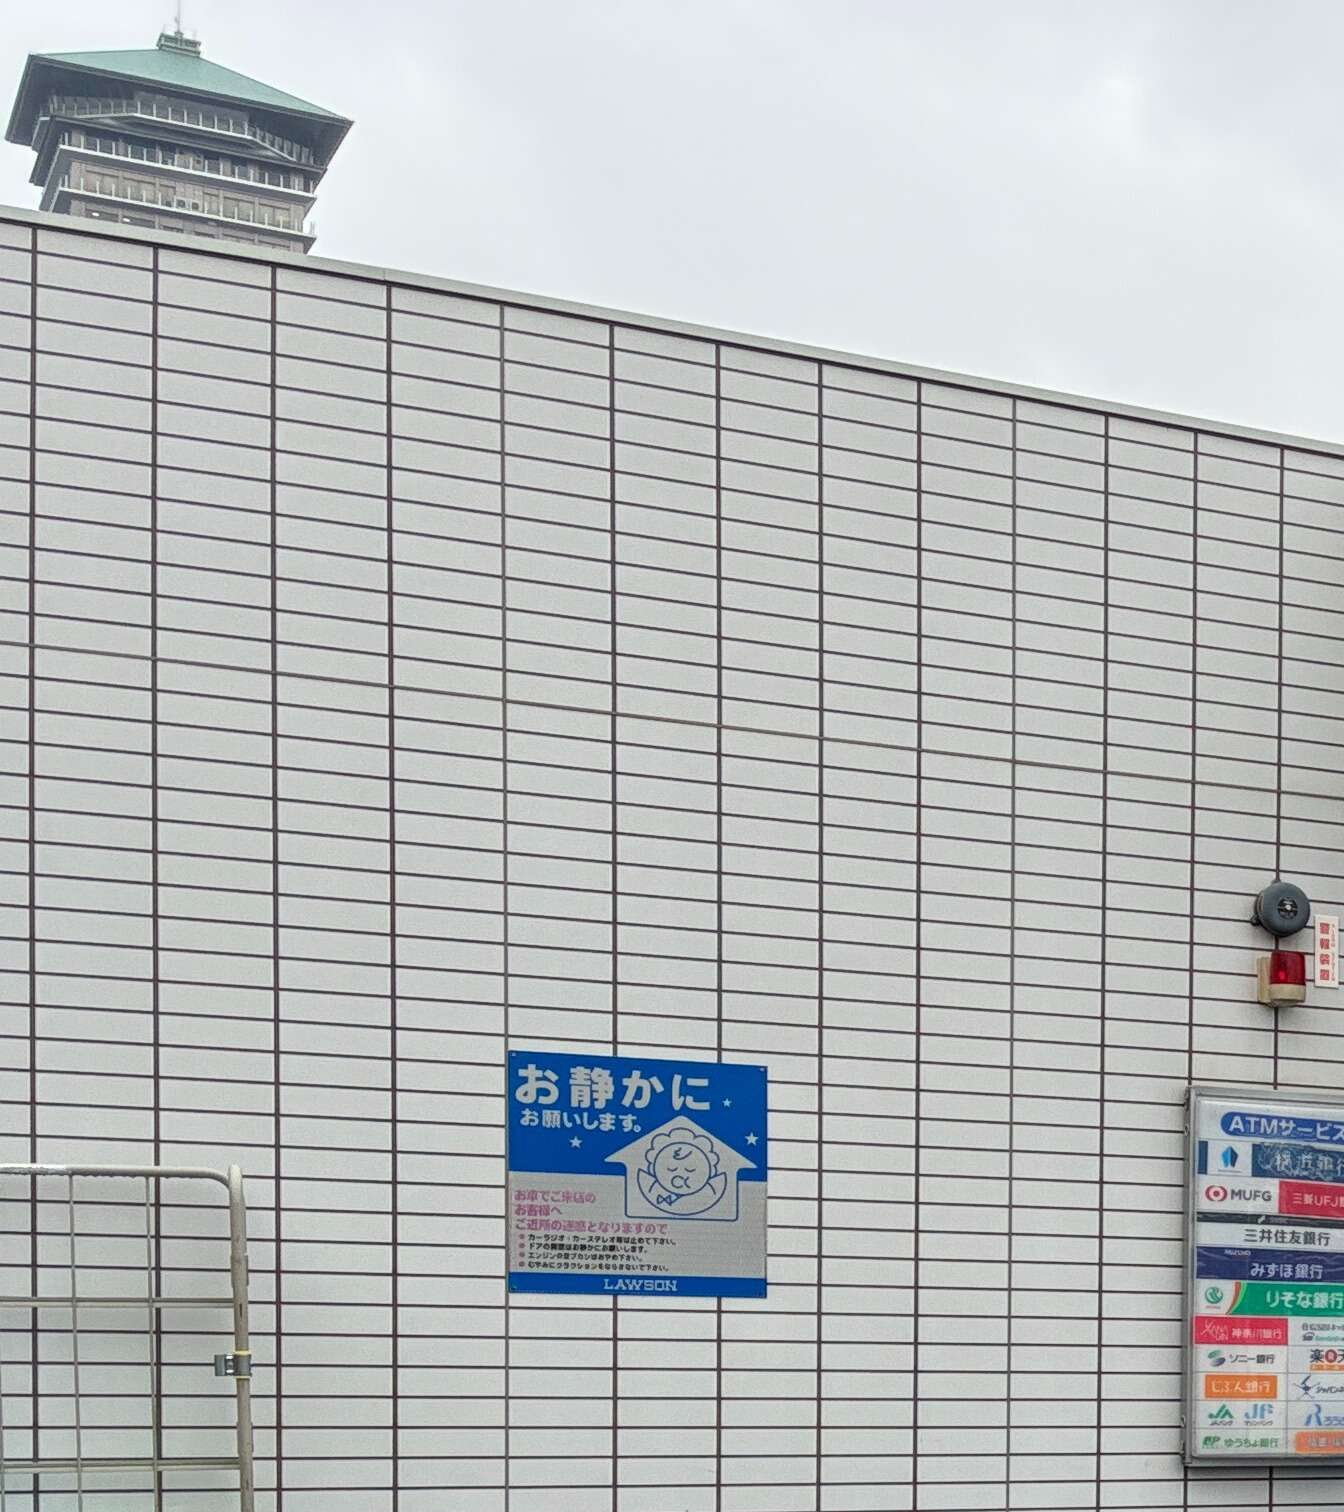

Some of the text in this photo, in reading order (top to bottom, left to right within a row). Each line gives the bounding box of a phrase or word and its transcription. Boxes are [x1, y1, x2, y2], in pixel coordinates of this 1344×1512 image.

[514, 1063, 711, 1111] お静かに
[519, 1108, 643, 1132] お願いします。
[1230, 1189, 1273, 1202] MUFG
[1243, 1228, 1332, 1246] 三井住友銀行
[1250, 1261, 1324, 1279] みずほ銀行
[603, 1278, 679, 1293] LAWSON
[1266, 1290, 1344, 1309] りそな銀行
[1229, 1353, 1275, 1365] ソニー銀行
[1211, 1379, 1271, 1393] じぶん銀行
[1224, 1438, 1279, 1448] ゆうちょ銀行
